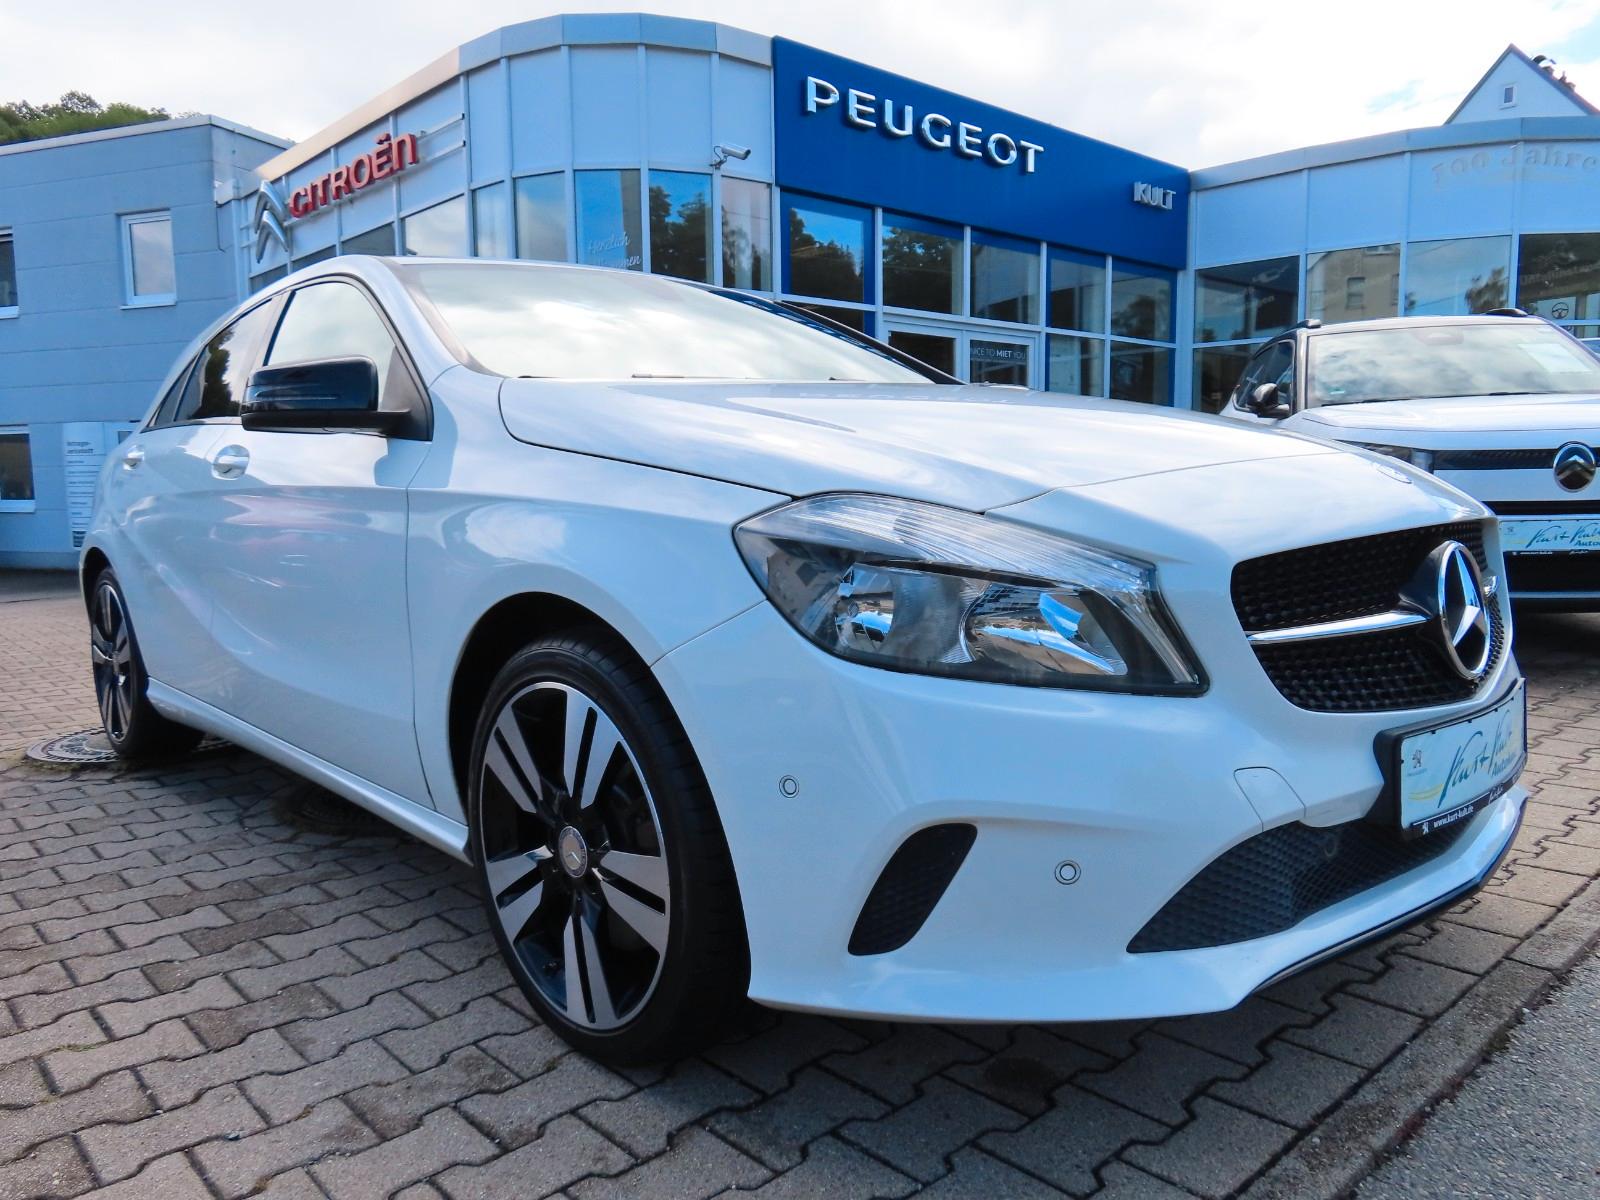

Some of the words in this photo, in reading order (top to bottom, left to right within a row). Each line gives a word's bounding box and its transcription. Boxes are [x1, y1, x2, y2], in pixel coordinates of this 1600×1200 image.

[806, 76, 1045, 174] PEUGEOT
[1133, 181, 1177, 210] KULT
[996, 350, 1012, 359] MIET
[1433, 804, 1475, 829] www.kurt-kult.de
